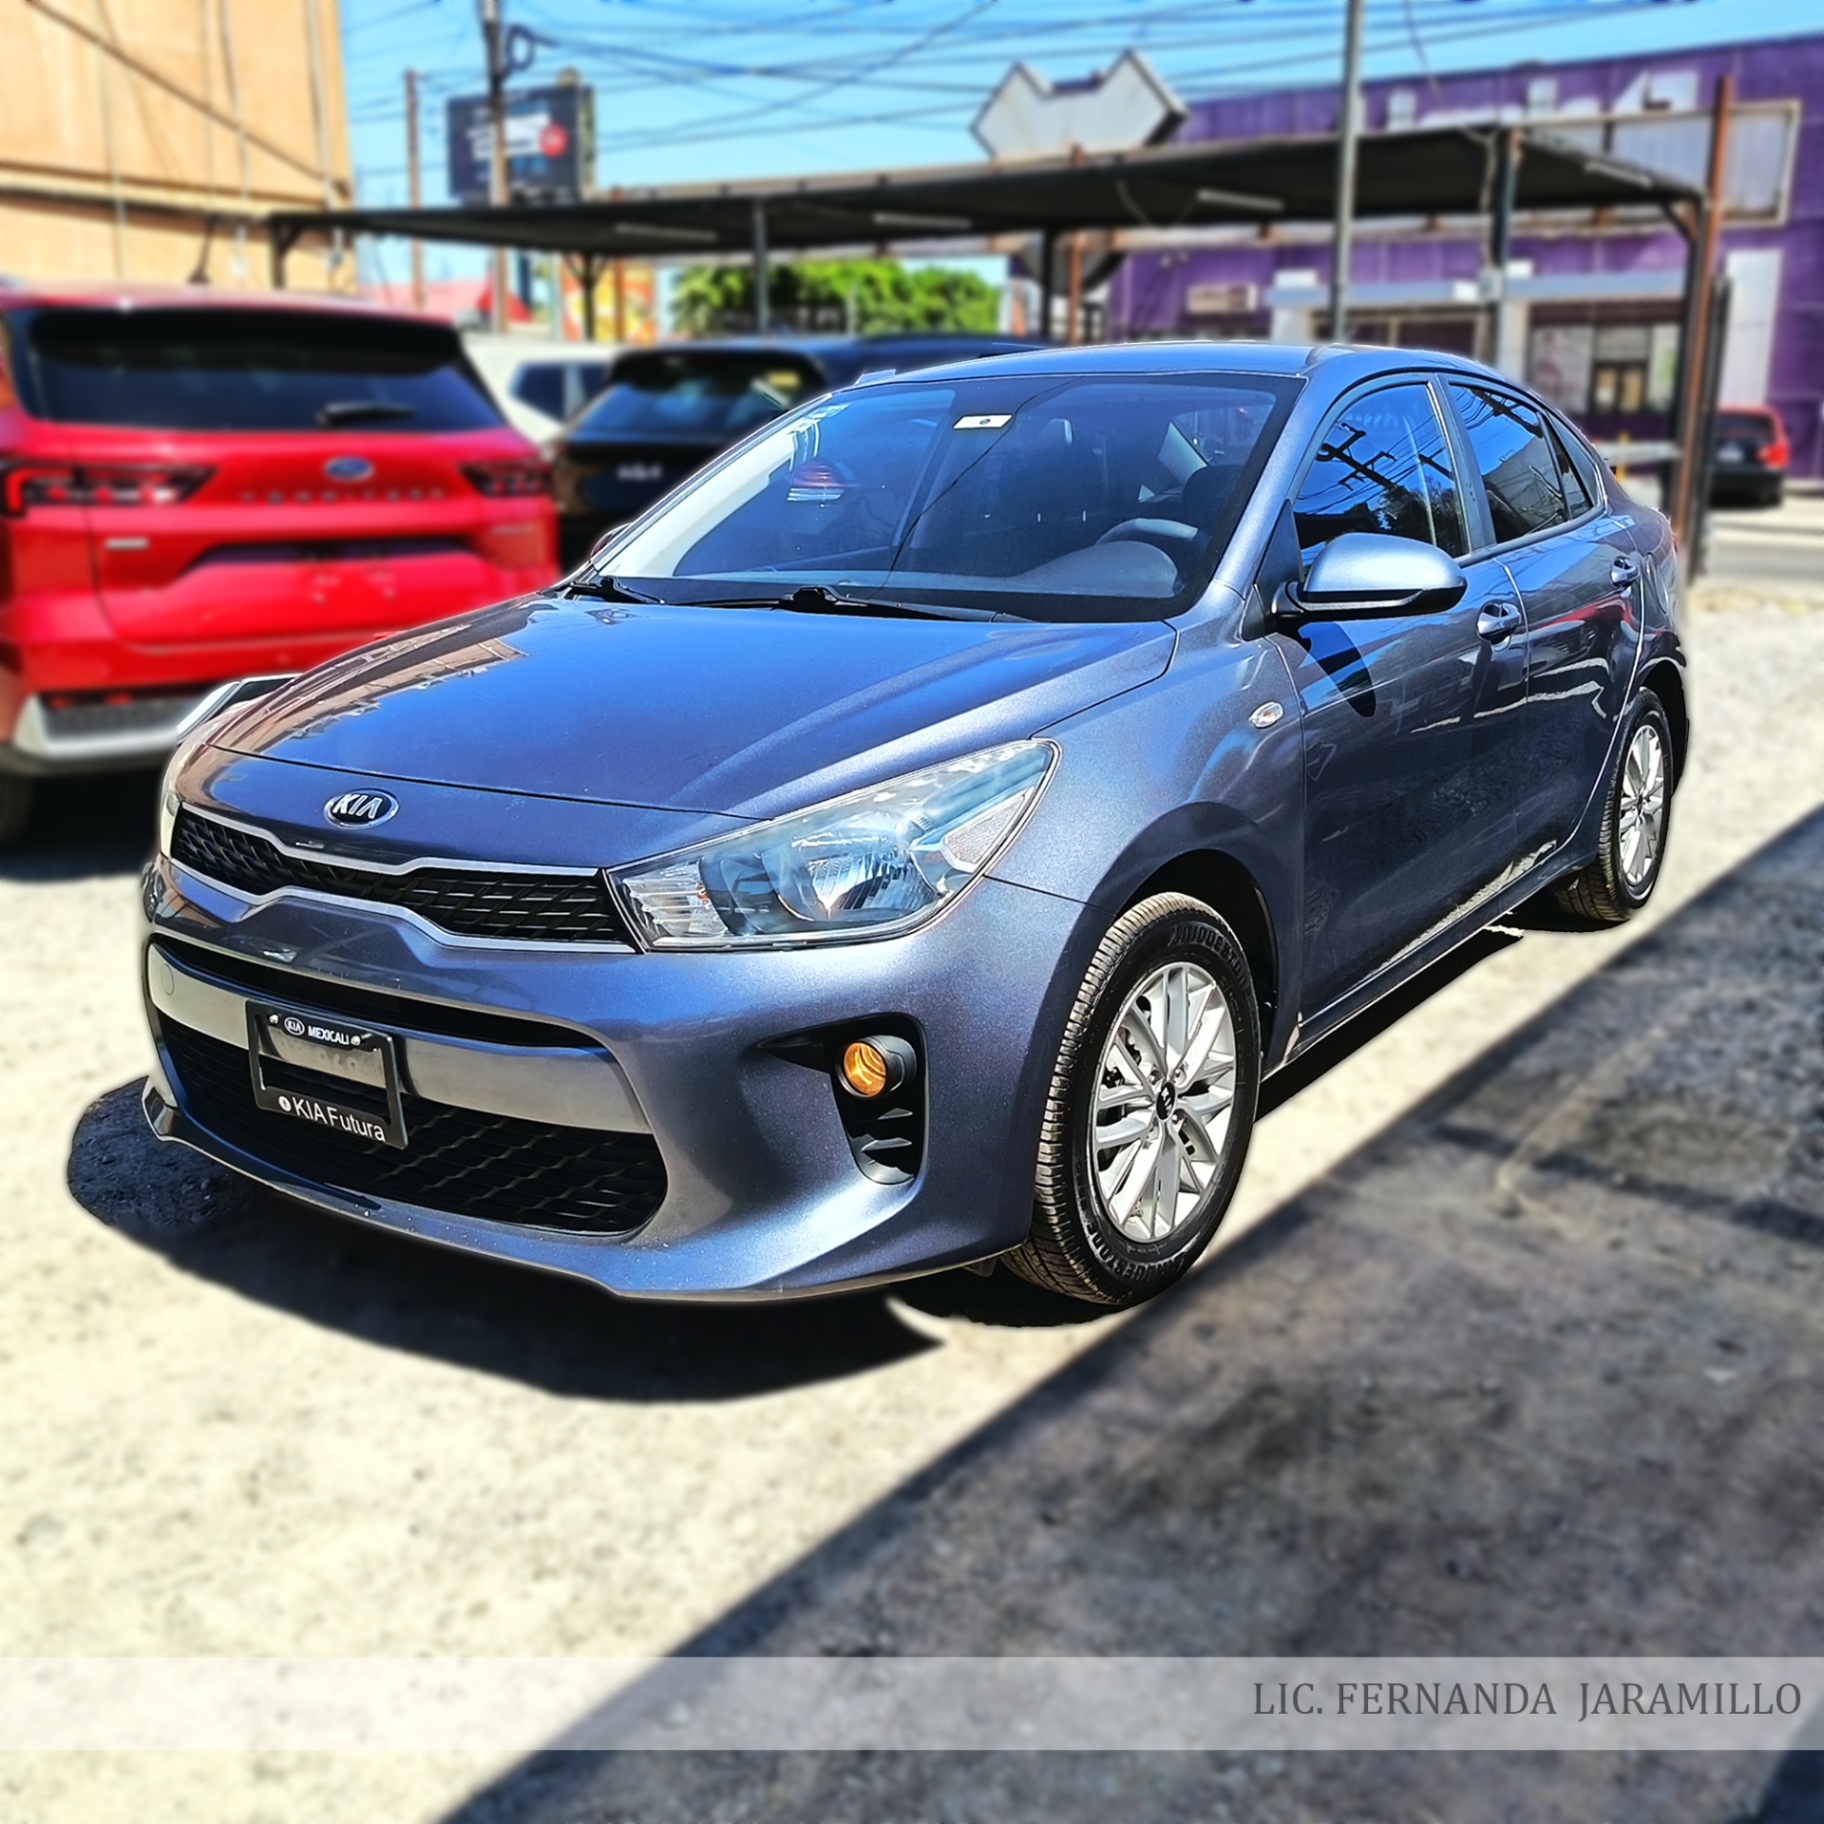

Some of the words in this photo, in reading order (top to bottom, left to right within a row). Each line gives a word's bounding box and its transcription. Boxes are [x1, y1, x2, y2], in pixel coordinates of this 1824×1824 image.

[332, 794, 383, 819] KIA
[287, 1020, 301, 1032] KIA
[307, 1025, 350, 1045] MEXICALI
[292, 1096, 328, 1125] KIA
[327, 1106, 386, 1142] Futura
